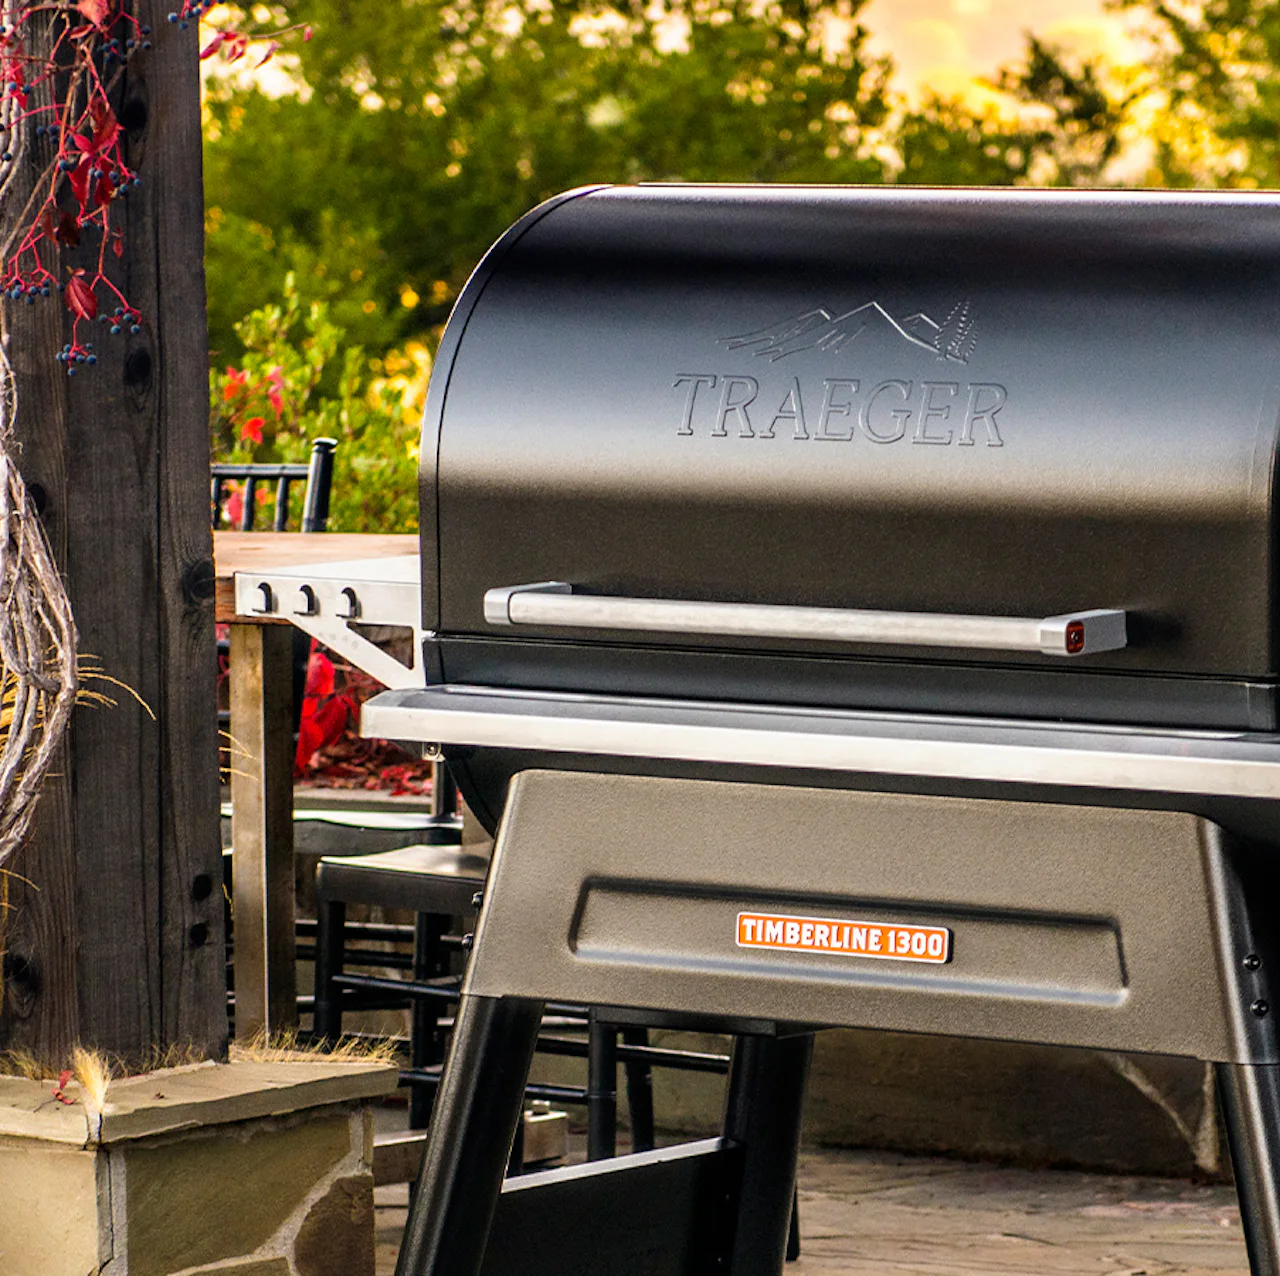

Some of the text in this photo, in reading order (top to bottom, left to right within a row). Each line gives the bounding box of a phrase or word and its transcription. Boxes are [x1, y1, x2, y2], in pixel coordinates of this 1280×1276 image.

[672, 372, 1009, 447] TRAEGER
[742, 918, 943, 957] TIMBERLINE 1300
